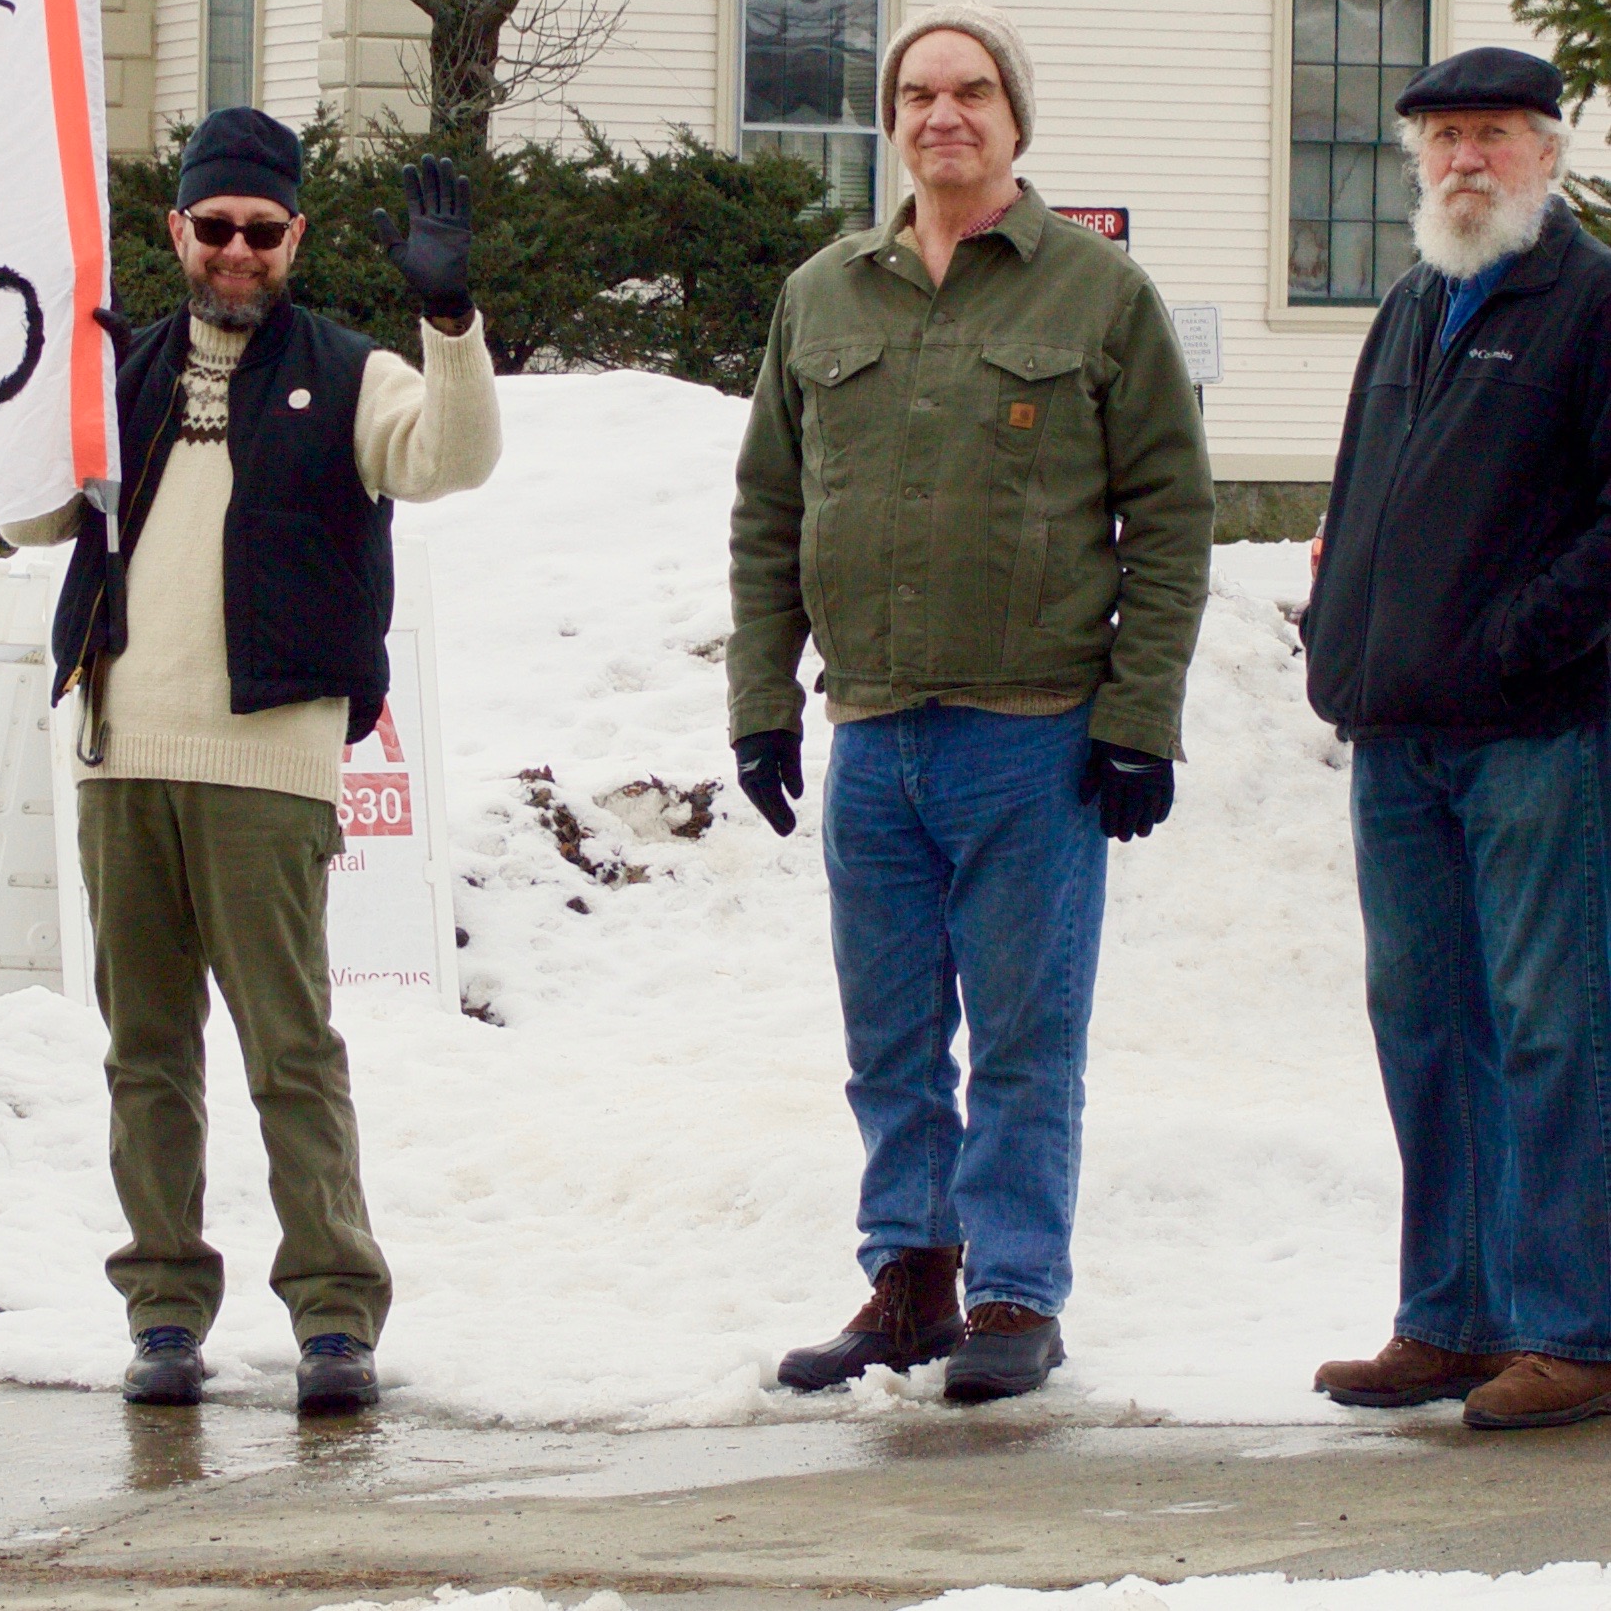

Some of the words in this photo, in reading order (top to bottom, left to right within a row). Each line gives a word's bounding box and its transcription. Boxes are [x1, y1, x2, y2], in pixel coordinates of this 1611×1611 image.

[1071, 213, 1115, 233] NGER
[337, 787, 403, 829] $30
[328, 849, 366, 871] atal
[331, 966, 430, 987] Vious
